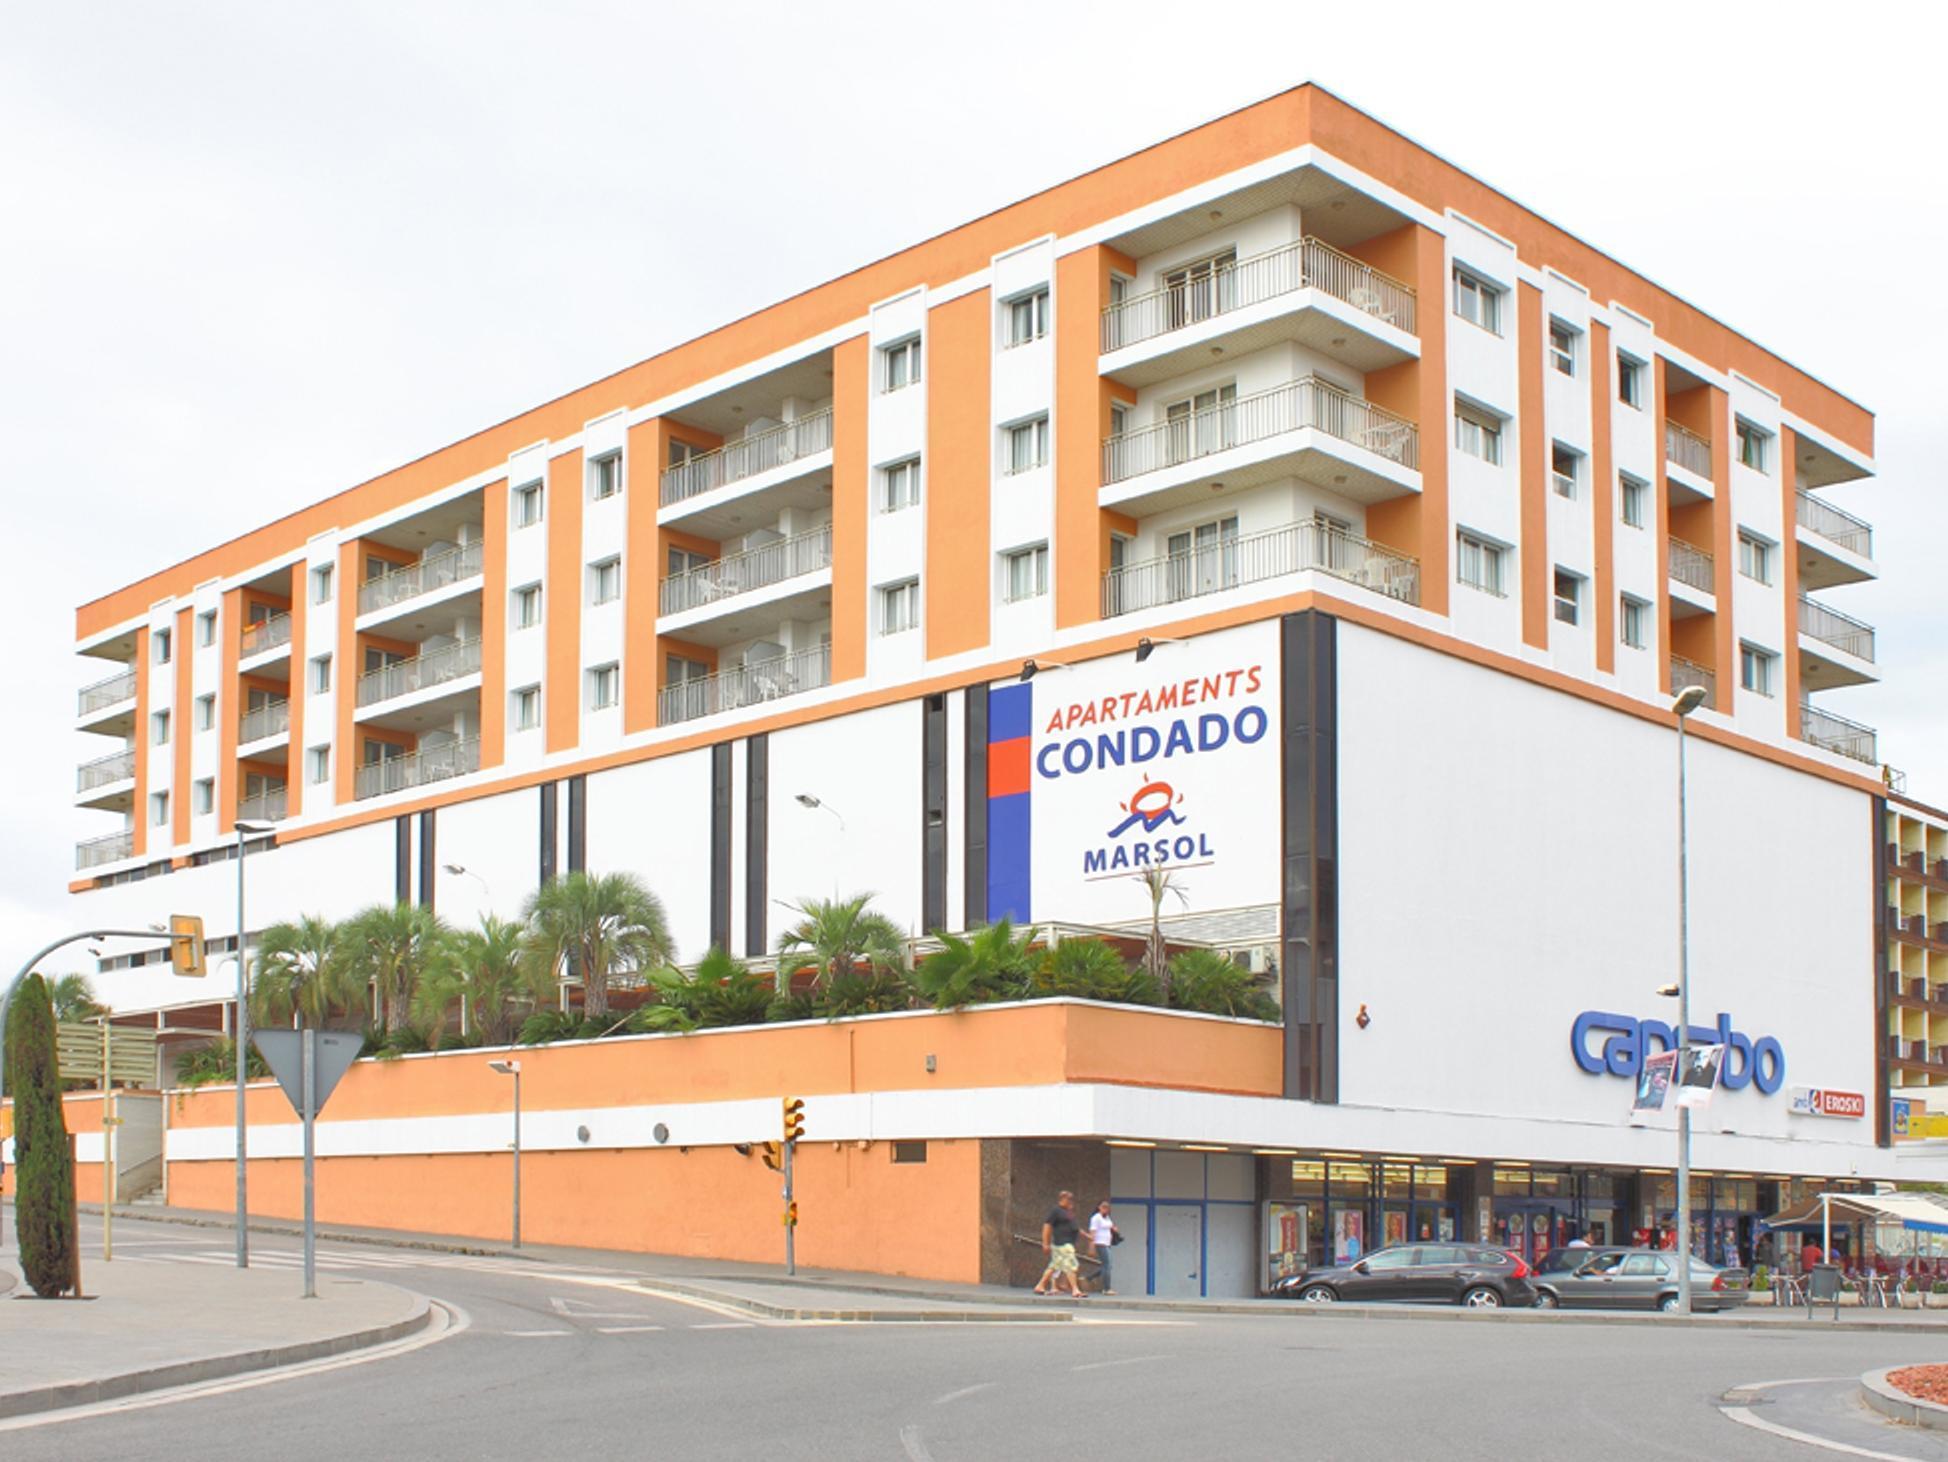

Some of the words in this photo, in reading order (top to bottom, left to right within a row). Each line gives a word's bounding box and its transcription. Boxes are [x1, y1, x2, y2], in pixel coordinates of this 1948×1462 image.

[1046, 665, 1262, 734] APARTAMENTS
[1036, 706, 1269, 778] CONDADO
[1084, 833, 1215, 873] MARSOL
[1826, 1095, 1863, 1112] EROSKI
